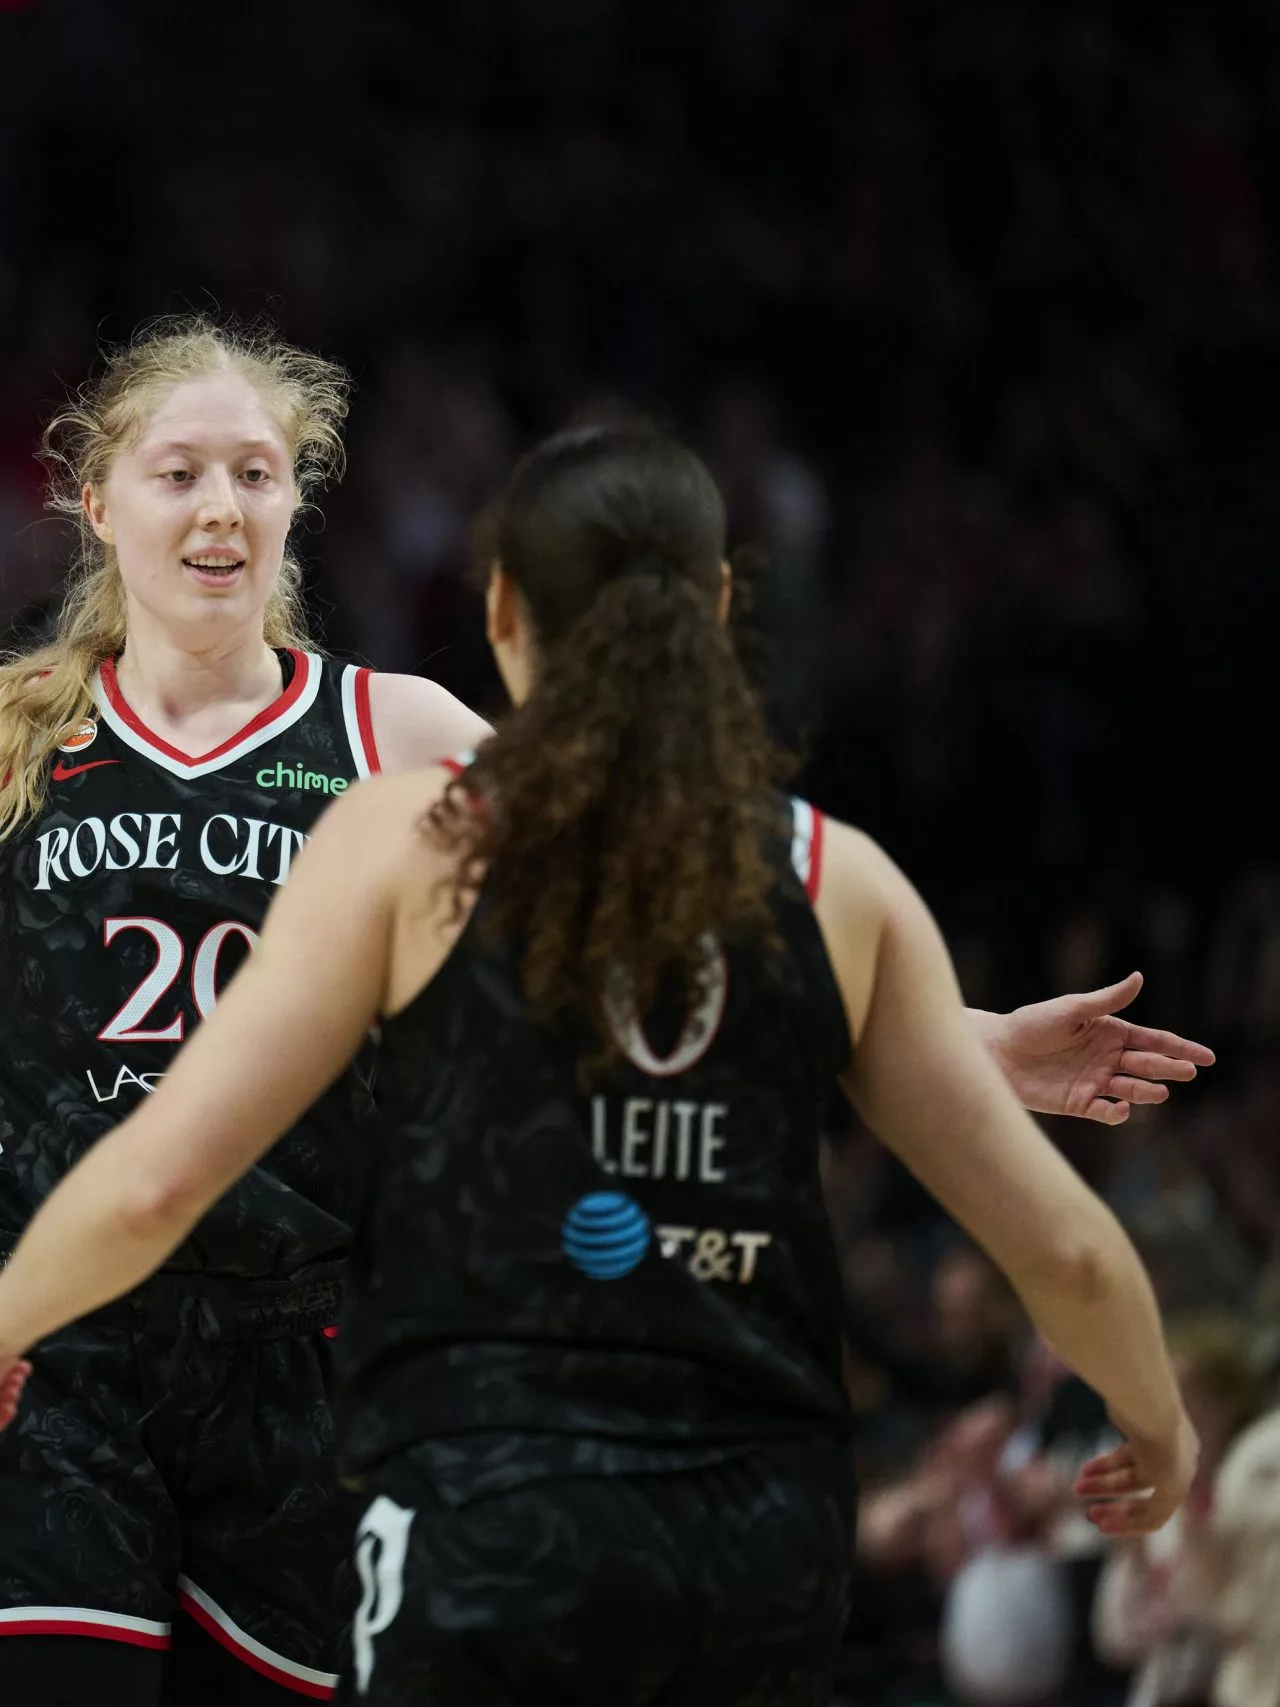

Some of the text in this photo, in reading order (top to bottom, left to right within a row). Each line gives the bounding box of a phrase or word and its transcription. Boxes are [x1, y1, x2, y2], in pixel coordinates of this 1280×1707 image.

[257, 762, 348, 797] chime
[33, 812, 312, 890] ROSE CIT
[592, 1095, 728, 1182] LEITE
